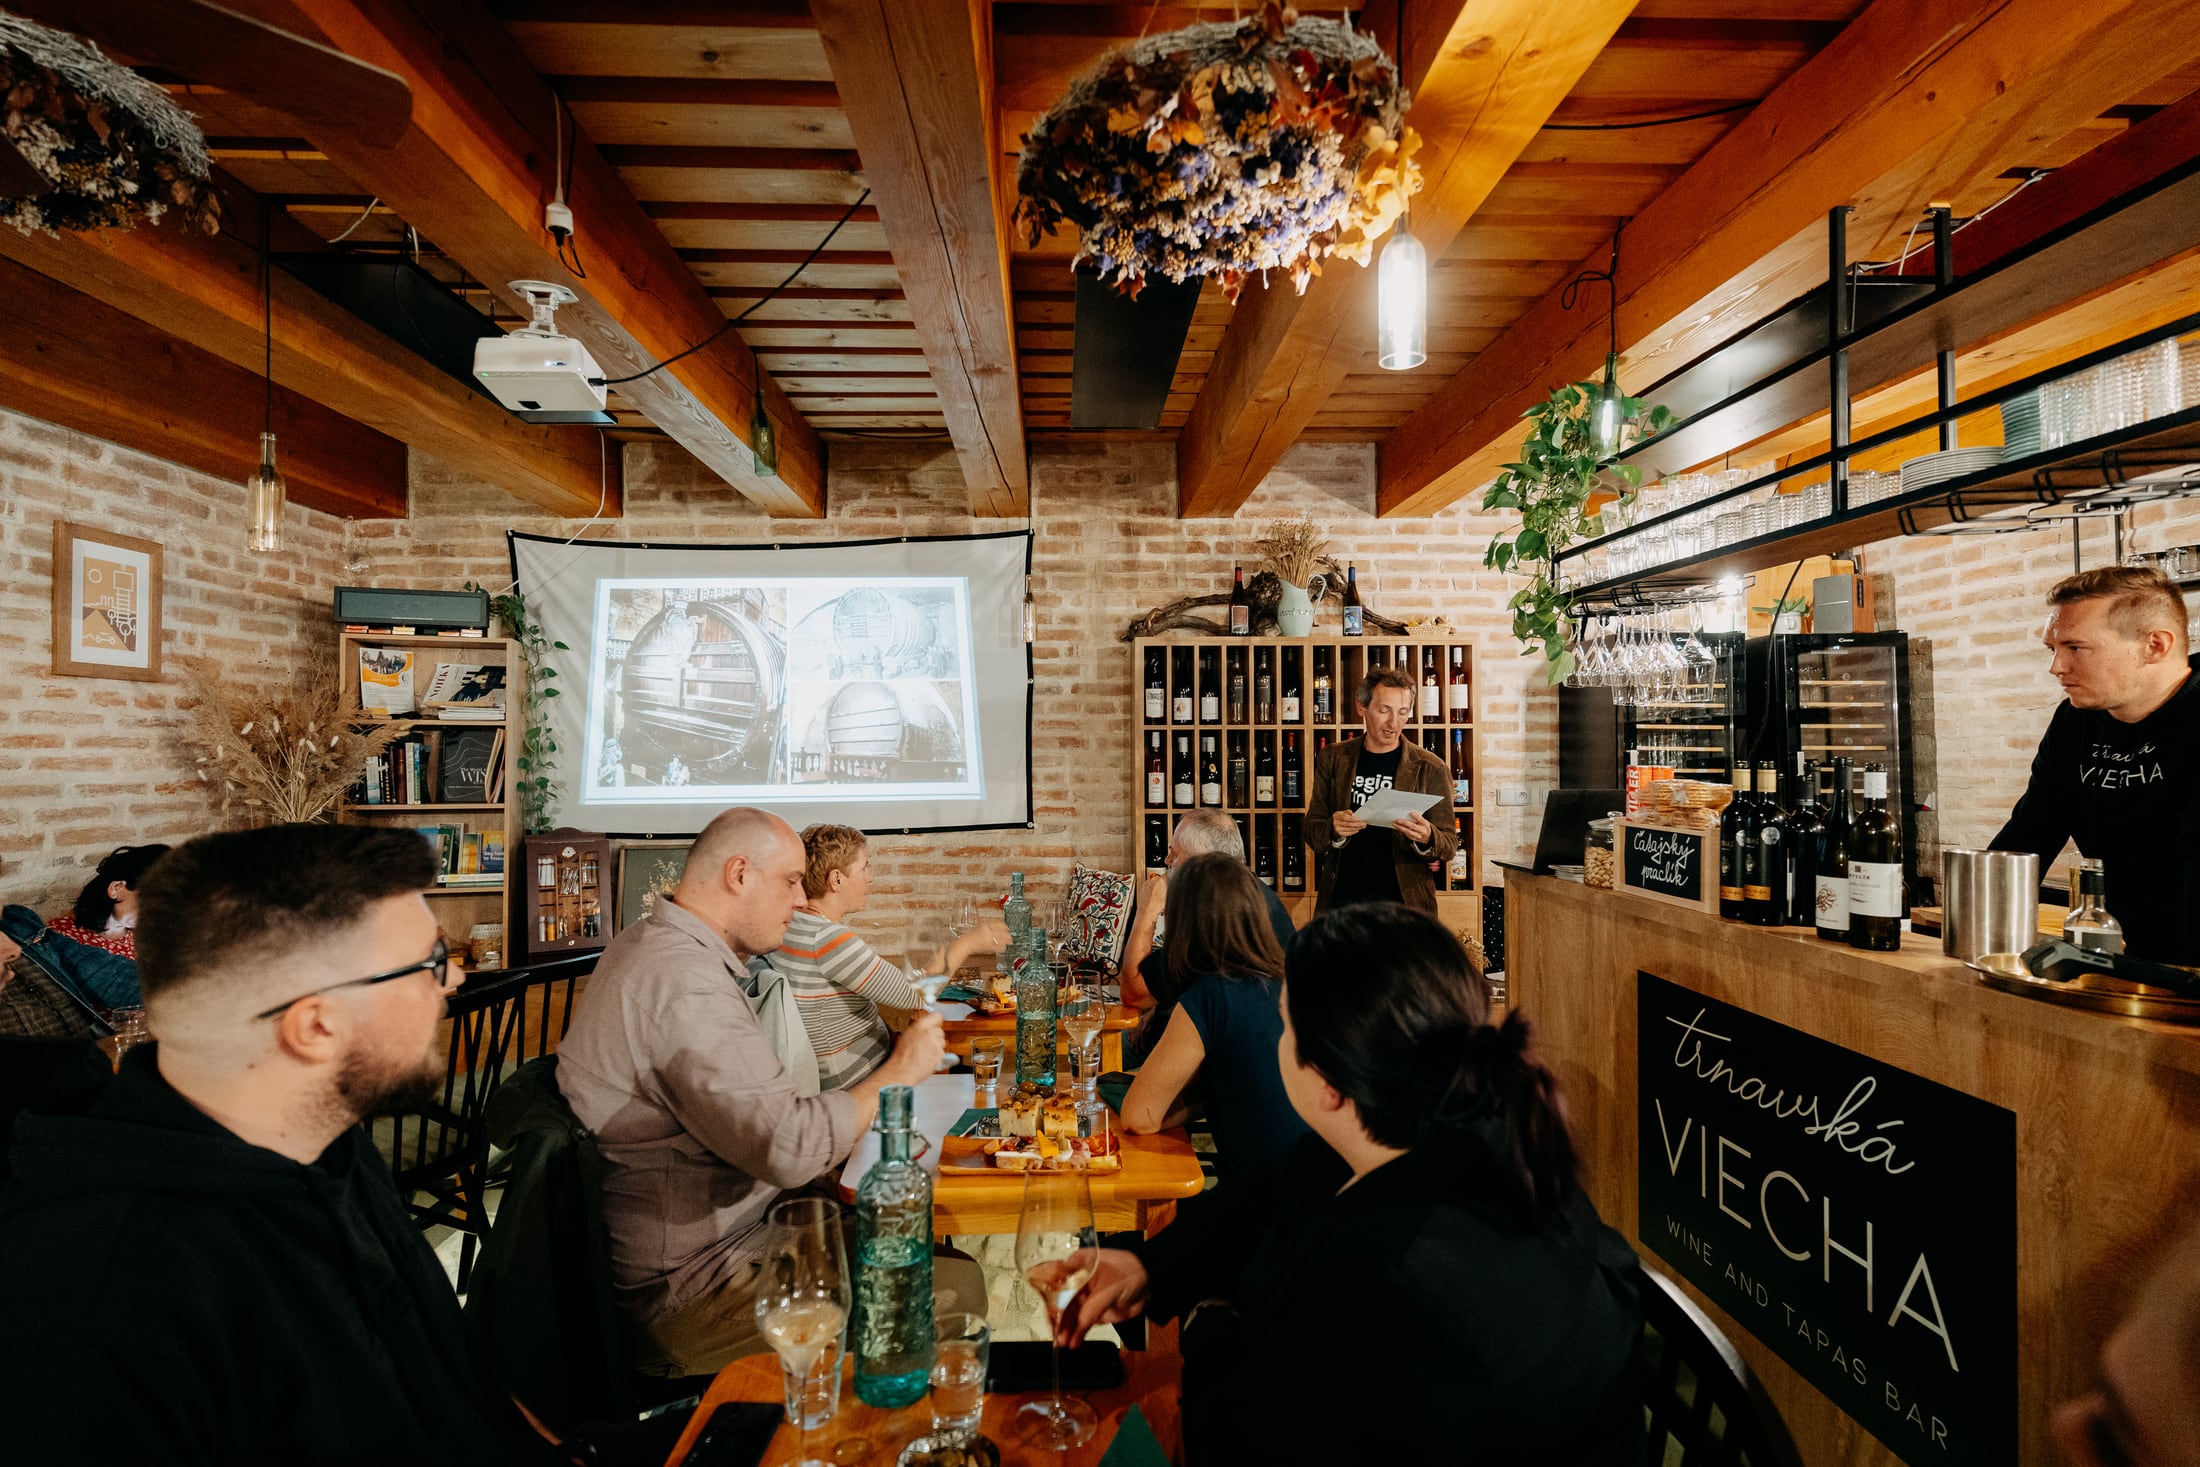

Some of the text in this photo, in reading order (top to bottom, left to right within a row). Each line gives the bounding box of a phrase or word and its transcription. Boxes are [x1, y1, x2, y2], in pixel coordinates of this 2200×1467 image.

[1641, 861, 1689, 887] praclík
[1666, 1008, 1915, 1175] trnavská
[1655, 1098, 1960, 1373] VIECHA
[1666, 1214, 1949, 1451] WINE AND TAPAS BAR
